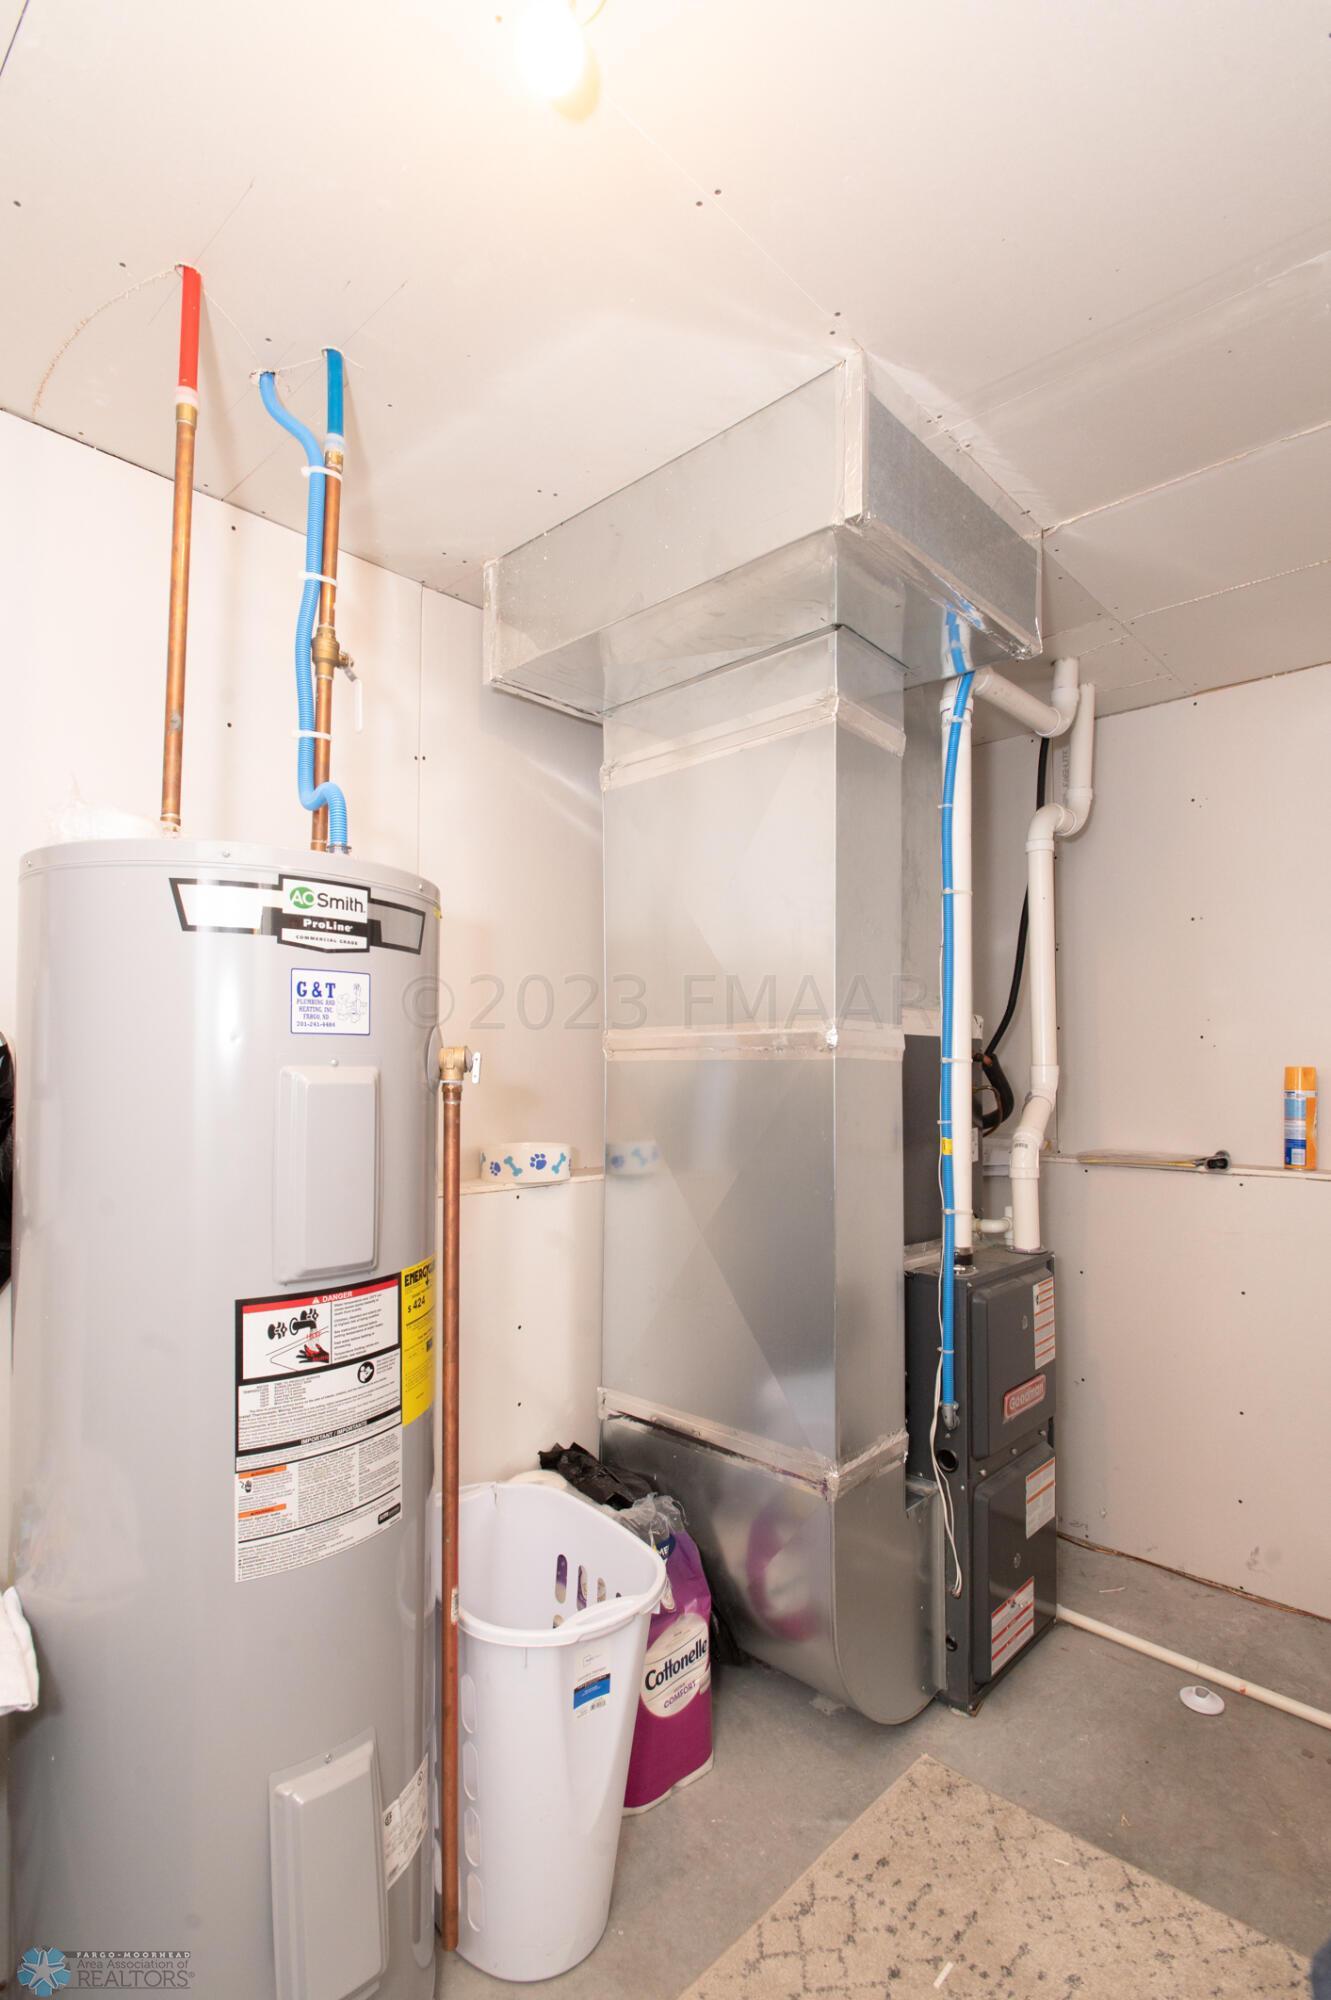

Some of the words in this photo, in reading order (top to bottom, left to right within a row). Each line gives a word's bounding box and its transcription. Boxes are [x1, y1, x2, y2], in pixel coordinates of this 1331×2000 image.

[317, 893, 364, 913] Smith
[303, 918, 352, 932] ProLine
[296, 981, 307, 997] G
[312, 981, 322, 998] &
[325, 982, 336, 998] T
[322, 1291, 353, 1303] DANGER
[645, 1638, 707, 1690] Cottonelle
[663, 1680, 697, 1708] COMFORT
